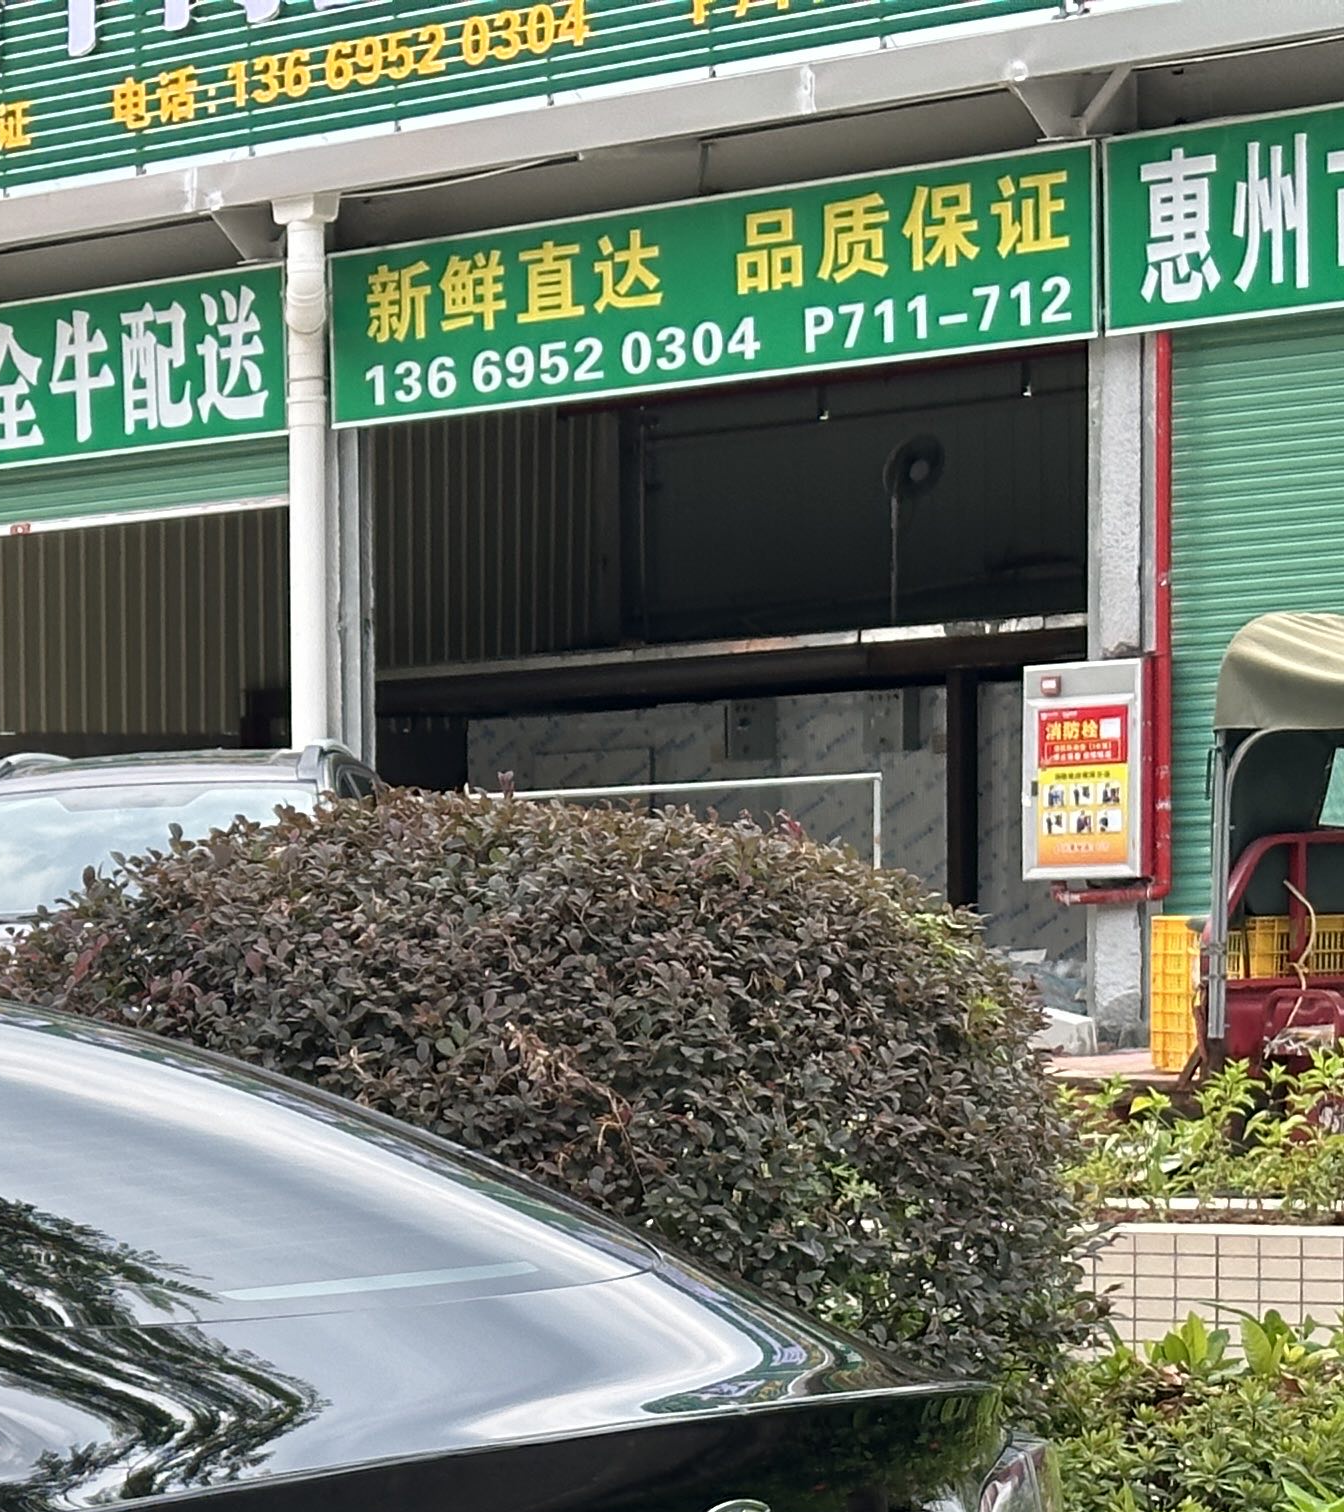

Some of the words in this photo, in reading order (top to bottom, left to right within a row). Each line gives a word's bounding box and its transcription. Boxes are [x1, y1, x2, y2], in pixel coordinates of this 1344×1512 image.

[325, 25, 446, 91] 6952
[461, 6, 589, 66] 0304
[366, 229, 663, 344] 新鲜直达
[736, 170, 1070, 296] 品质保证
[365, 356, 458, 406] 136
[472, 337, 605, 394] 6952
[621, 316, 761, 376] 0304
[804, 276, 1072, 353] P711-712
[1045, 718, 1099, 741] 消防栓
